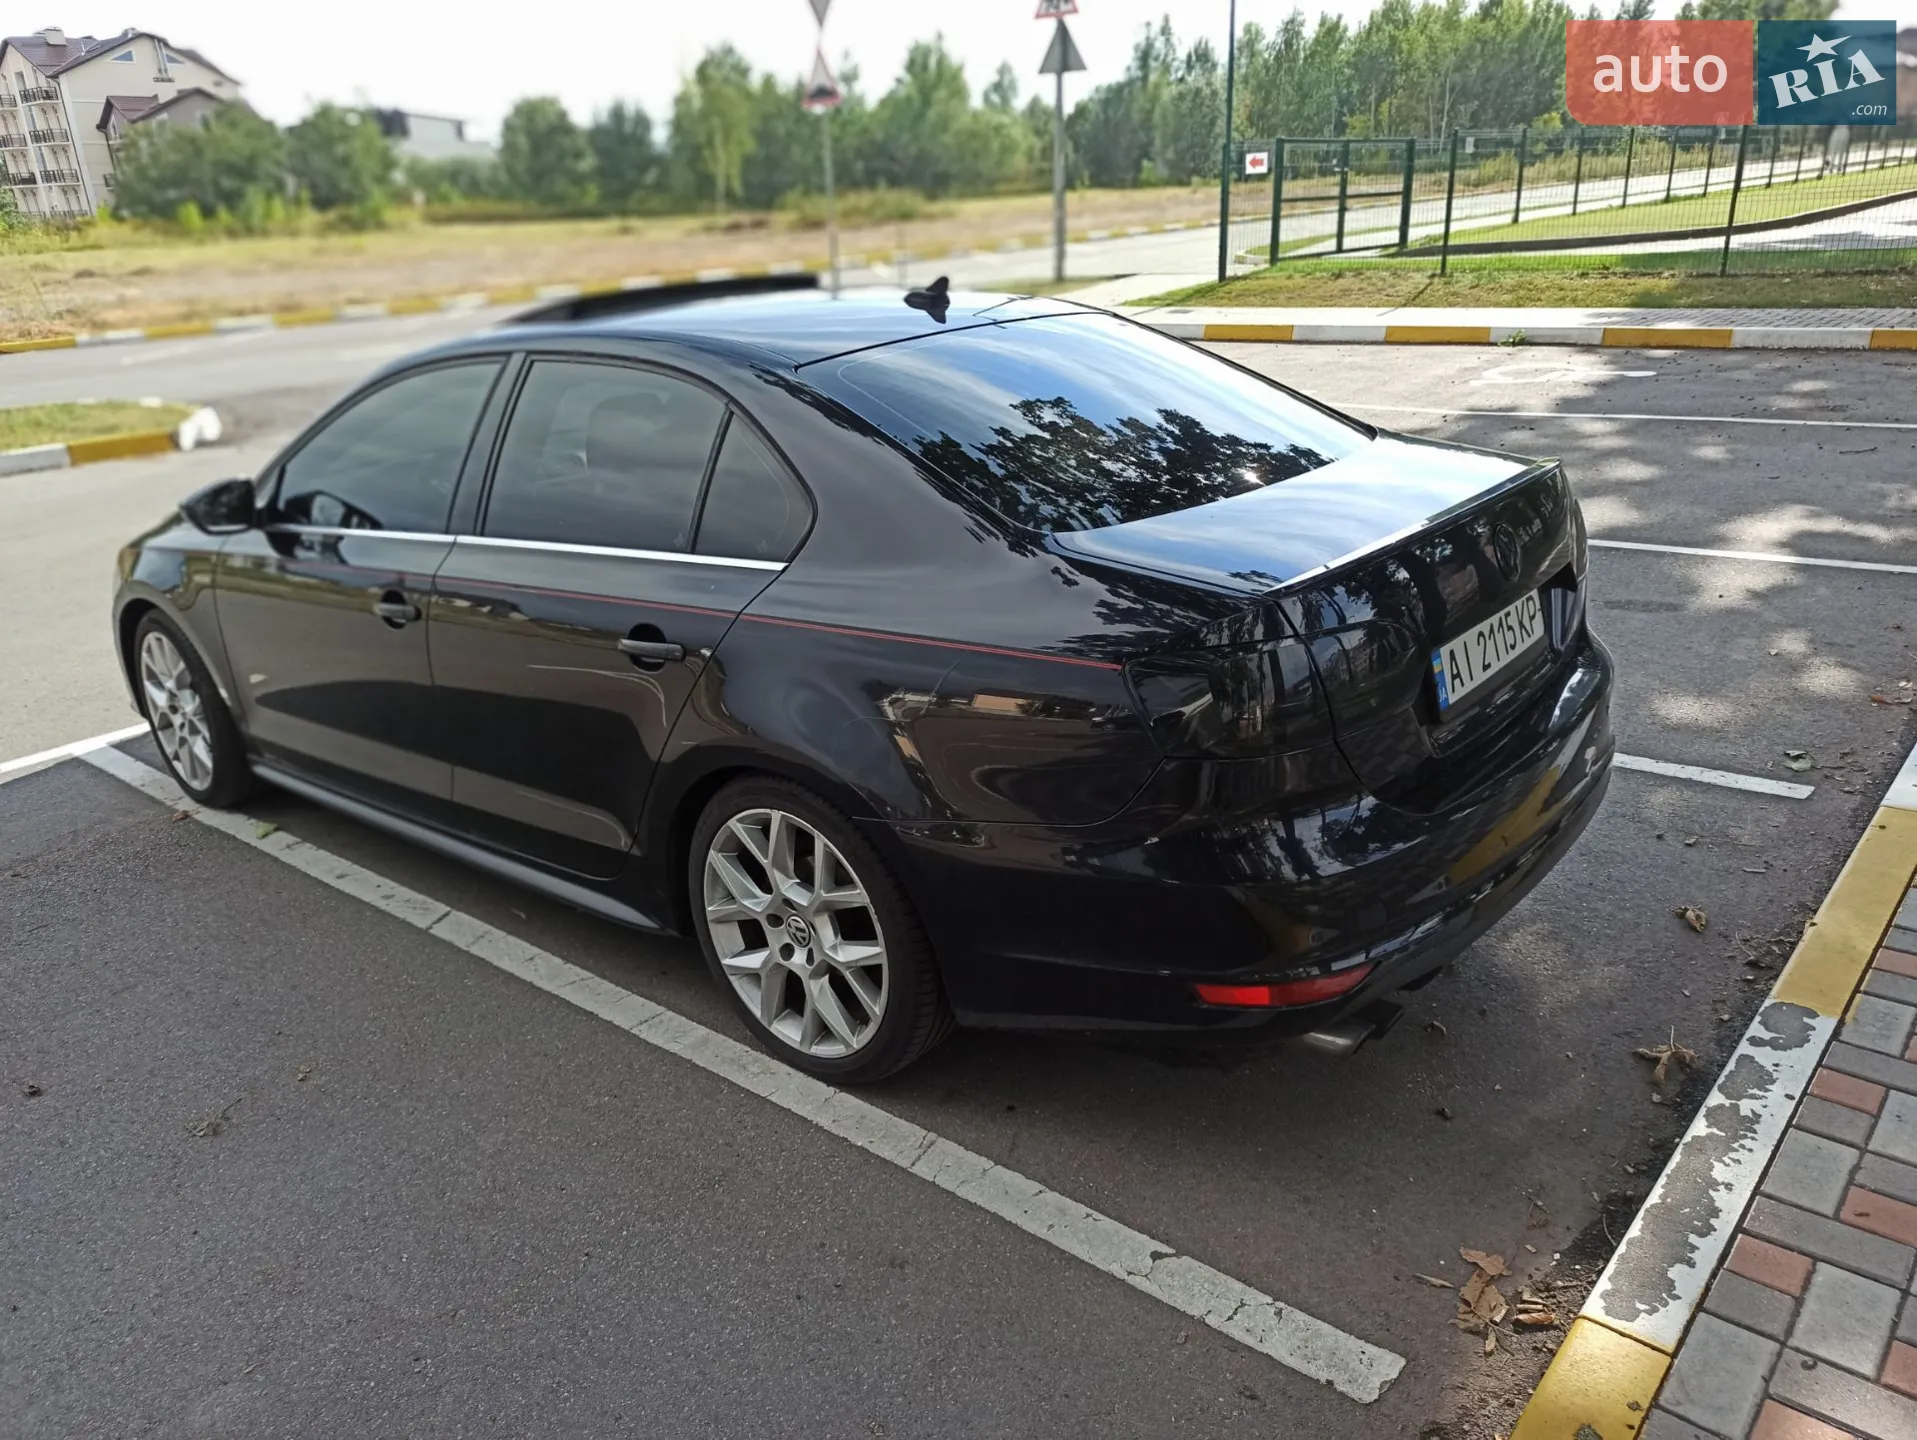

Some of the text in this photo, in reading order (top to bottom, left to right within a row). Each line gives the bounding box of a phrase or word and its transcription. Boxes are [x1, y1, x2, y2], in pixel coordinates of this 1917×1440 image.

[1450, 594, 1537, 694] AI 2115 KP
